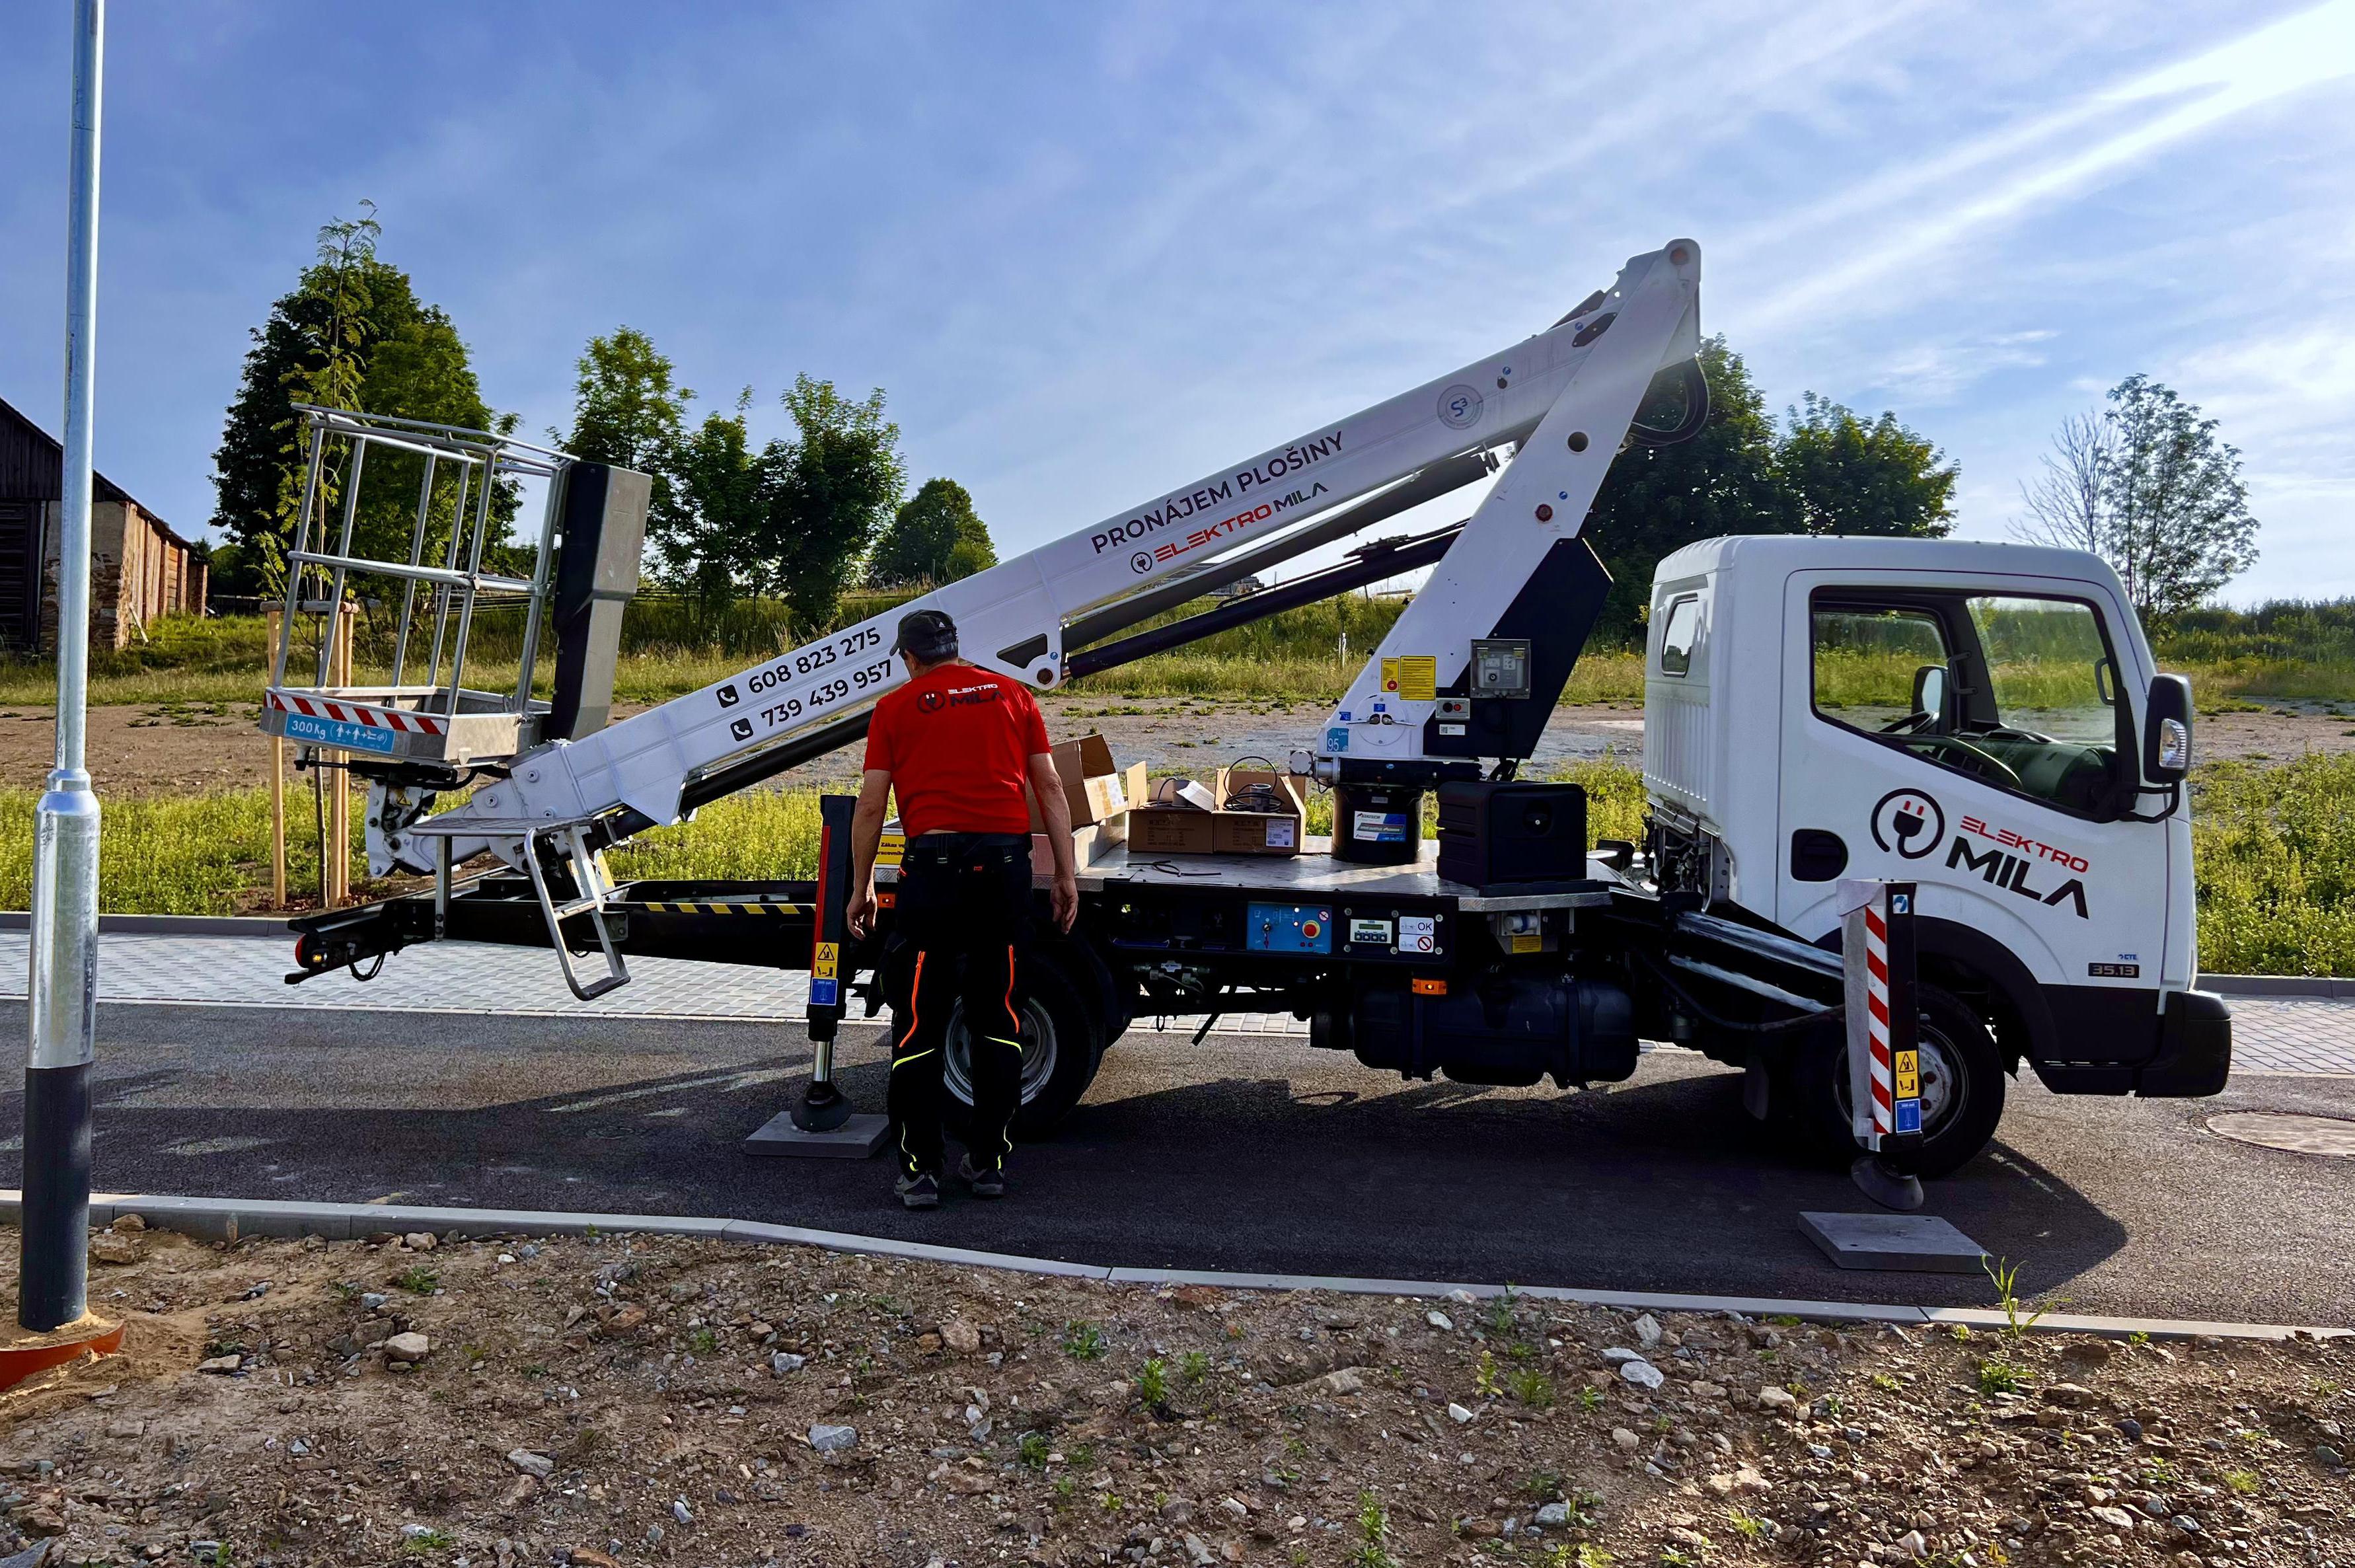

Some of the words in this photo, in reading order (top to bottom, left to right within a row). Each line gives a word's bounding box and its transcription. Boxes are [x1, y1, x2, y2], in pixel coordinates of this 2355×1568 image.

[1091, 480, 1233, 554] PRONÁJEM
[1236, 430, 1343, 493] PLOŠINY
[1154, 504, 1273, 562] ELEKTRO
[1273, 482, 1329, 513] MILA
[749, 665, 792, 694] 608
[796, 645, 837, 674] 823
[839, 626, 881, 657] 275
[948, 683, 998, 694] ELEKTRO
[760, 698, 802, 728] 739
[809, 679, 850, 707] 439
[853, 659, 891, 689] 957
[950, 691, 1006, 706] MILA
[1327, 737, 1339, 751] 95
[1960, 815, 2089, 874] ELEKTRO
[1945, 835, 2089, 920] MILA
[1417, 922, 1433, 932] OK
[2092, 965, 2136, 976] 35.13
